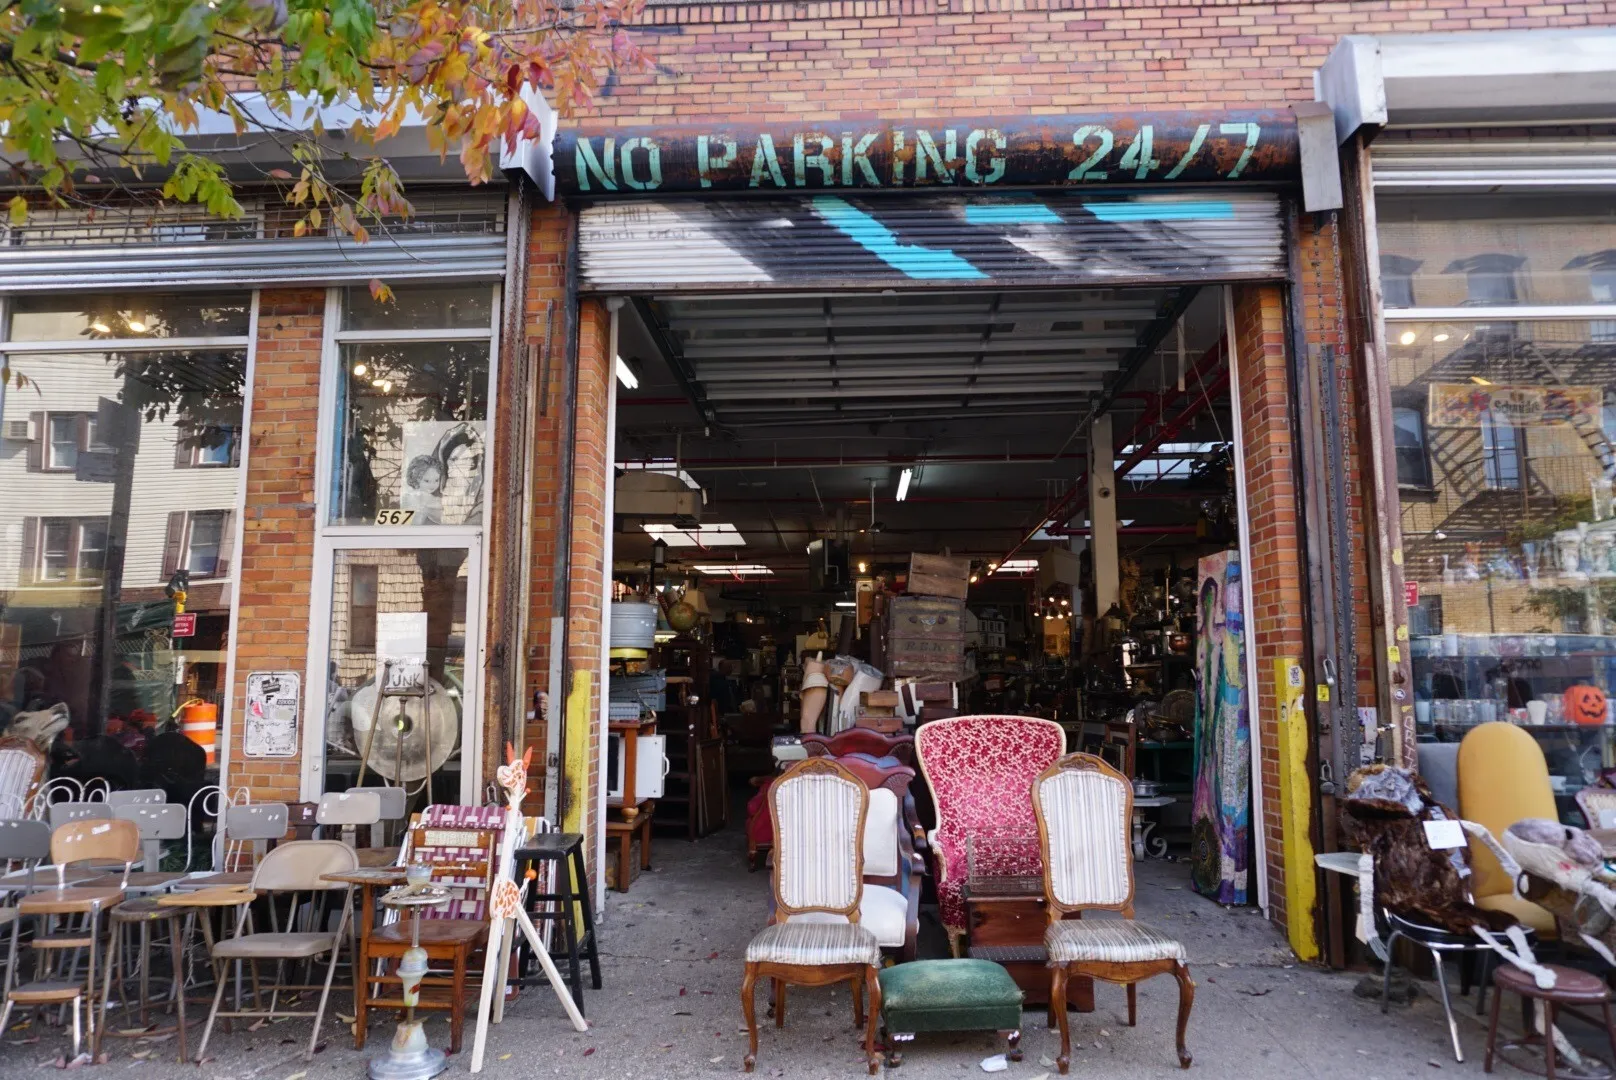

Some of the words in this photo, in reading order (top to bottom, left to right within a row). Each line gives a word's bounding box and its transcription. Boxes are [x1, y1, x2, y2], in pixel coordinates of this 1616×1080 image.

[575, 137, 663, 191] NO
[697, 128, 1007, 188] PARKING
[1068, 122, 1261, 180] 24/7
[377, 510, 415, 525] 567
